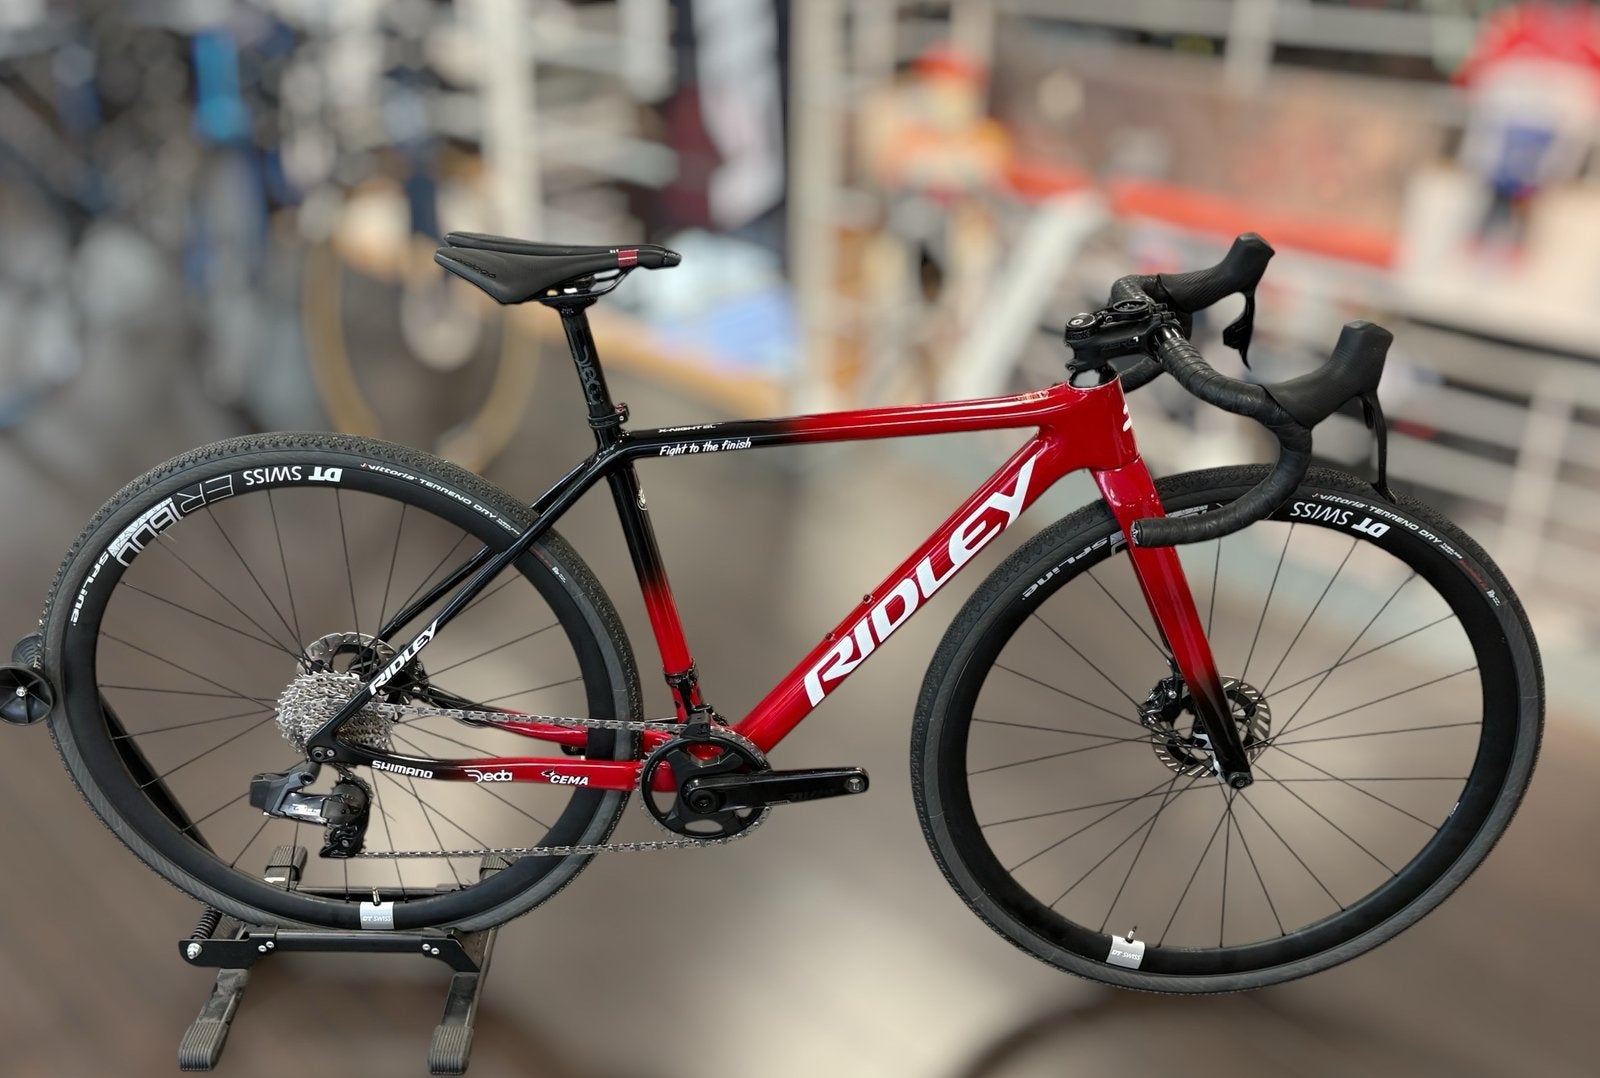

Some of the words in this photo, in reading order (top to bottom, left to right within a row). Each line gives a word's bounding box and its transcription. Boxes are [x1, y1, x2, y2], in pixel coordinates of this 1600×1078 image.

[659, 443, 688, 457] Fight
[689, 442, 700, 453] to
[703, 440, 719, 453] the
[721, 437, 752, 450] finish
[242, 465, 302, 486] SWISS
[308, 466, 343, 483] DT
[367, 463, 417, 481] vittoria
[420, 478, 471, 504] TERRENO
[473, 502, 497, 519] DRY
[1289, 501, 1354, 526] SWISS
[1319, 494, 1367, 509] vittoria
[1369, 505, 1419, 531] TERRENO
[1418, 529, 1442, 544] DRY
[1350, 517, 1391, 538] DT
[804, 454, 1037, 708] RIDLEY
[369, 619, 438, 695] RIDLEY
[372, 760, 434, 779] SHIMANO
[549, 774, 589, 786] CEMA
